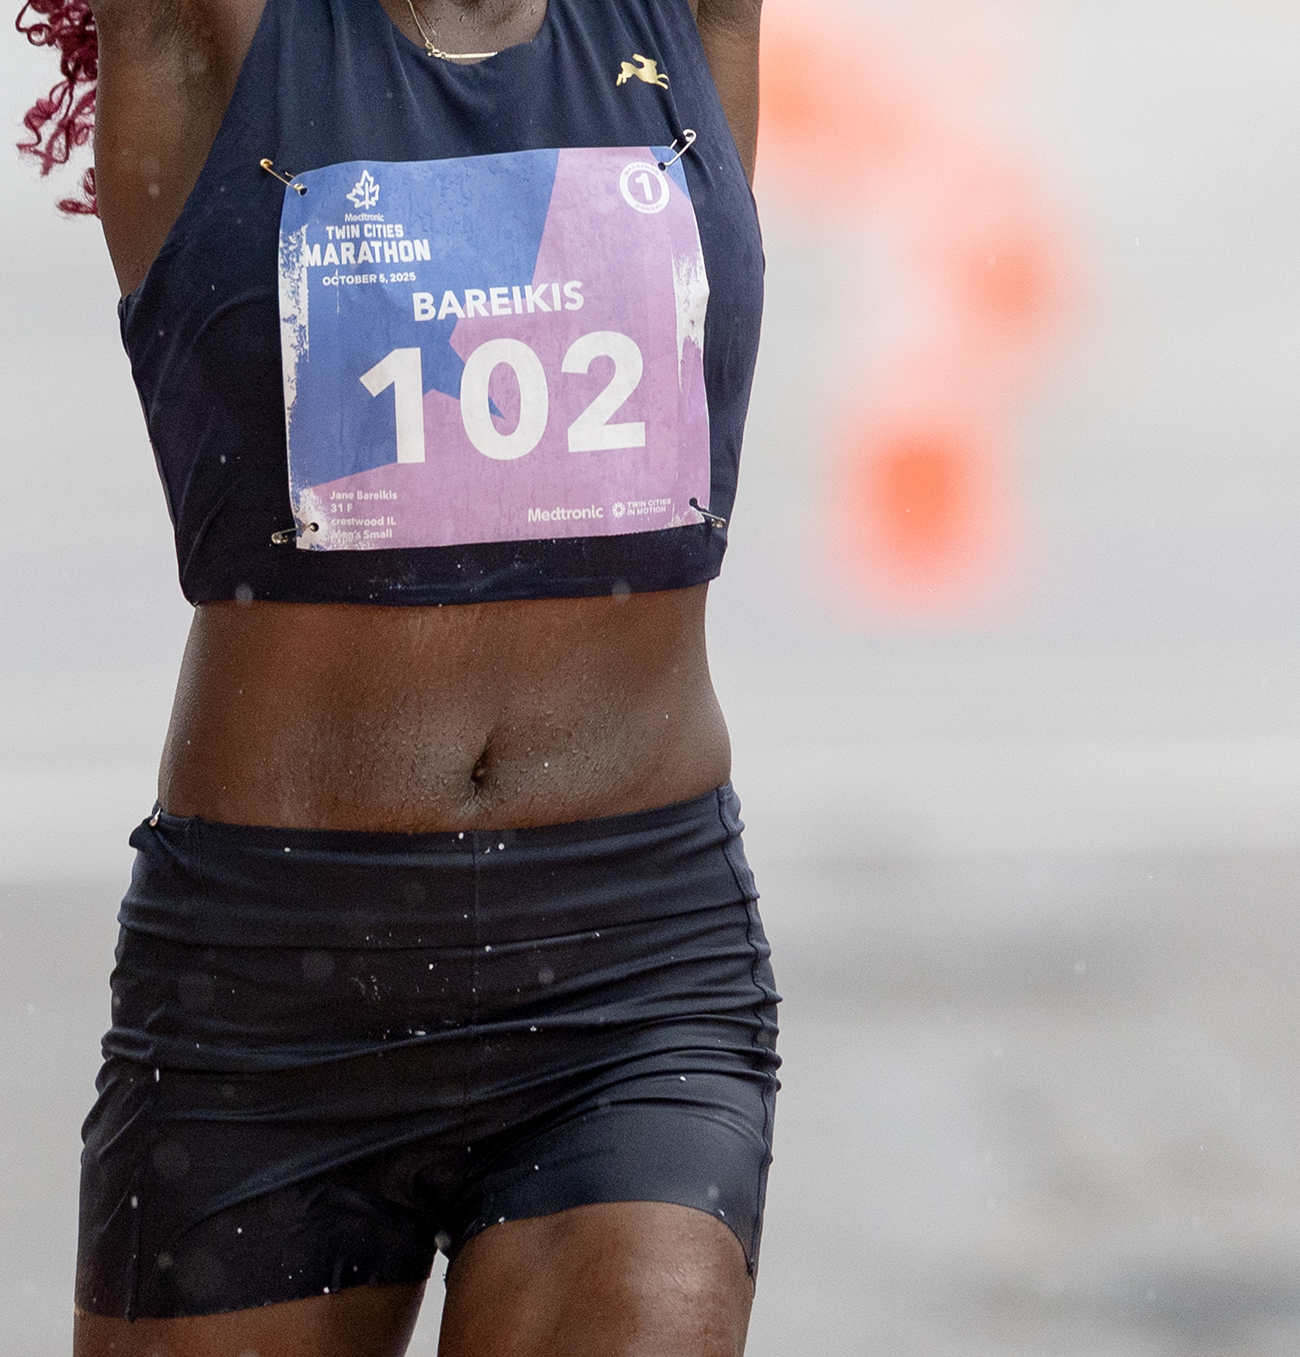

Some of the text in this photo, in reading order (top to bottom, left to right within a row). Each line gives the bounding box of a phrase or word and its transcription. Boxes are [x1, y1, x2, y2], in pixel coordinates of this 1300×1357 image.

[635, 172, 653, 201] 1
[344, 213, 384, 222] Medtronic
[326, 224, 404, 240] TWIN CITIES
[304, 239, 431, 267] MARATHON
[322, 272, 416, 286] OCTOBER 5, 2025
[412, 280, 585, 322] BAREIKIS
[359, 330, 646, 464] 102
[330, 490, 398, 500] Jane Bareikis
[648, 498, 671, 506] CITIES
[330, 504, 353, 513] 31 F
[528, 504, 604, 522] Medtronic
[628, 506, 666, 516] IN MOTION
[330, 516, 397, 526] crestwood IL
[364, 528, 393, 539] Small
